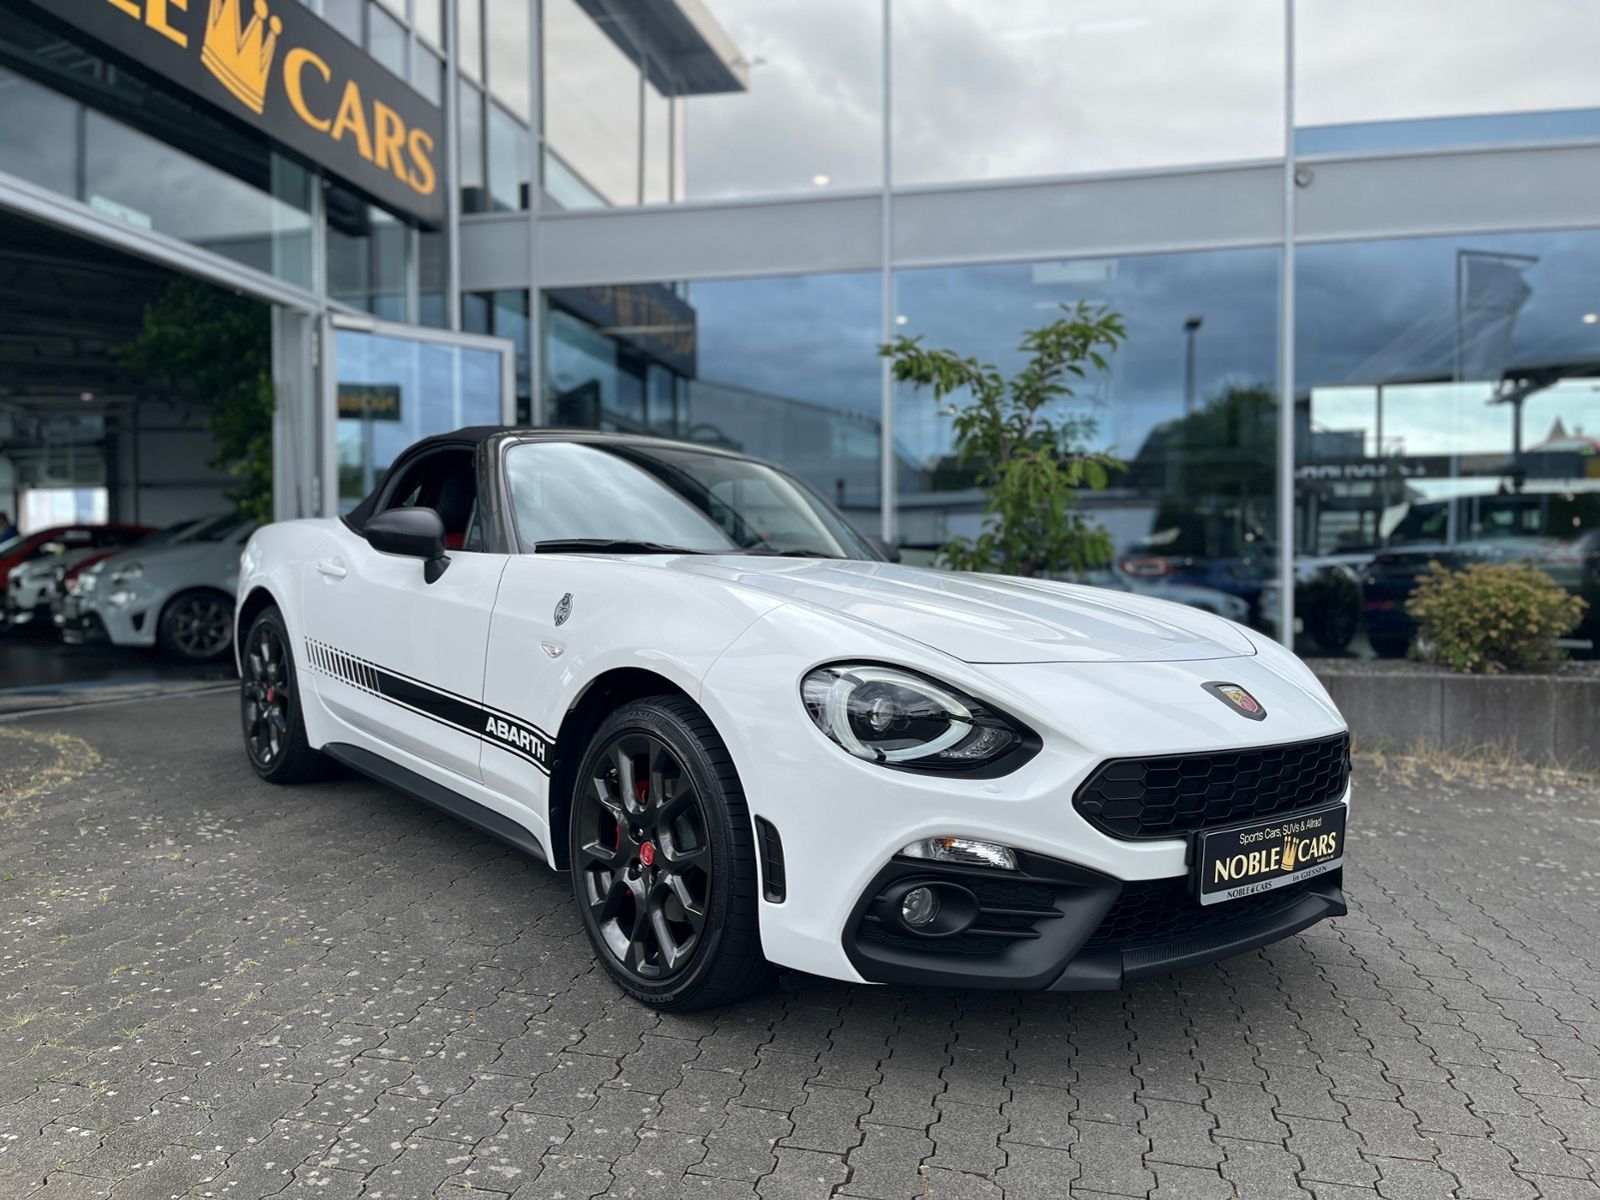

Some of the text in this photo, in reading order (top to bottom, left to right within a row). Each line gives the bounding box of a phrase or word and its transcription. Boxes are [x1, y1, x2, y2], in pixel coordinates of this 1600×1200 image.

[282, 46, 437, 196] CARS
[485, 716, 546, 762] ABARTH
[1239, 817, 1322, 845] Sports Cars, SUVs & Allrad
[1214, 832, 1336, 883] NOBLE CARS
[1292, 866, 1327, 882] in GIESSEN
[1227, 881, 1272, 898] NOBLE CARS
